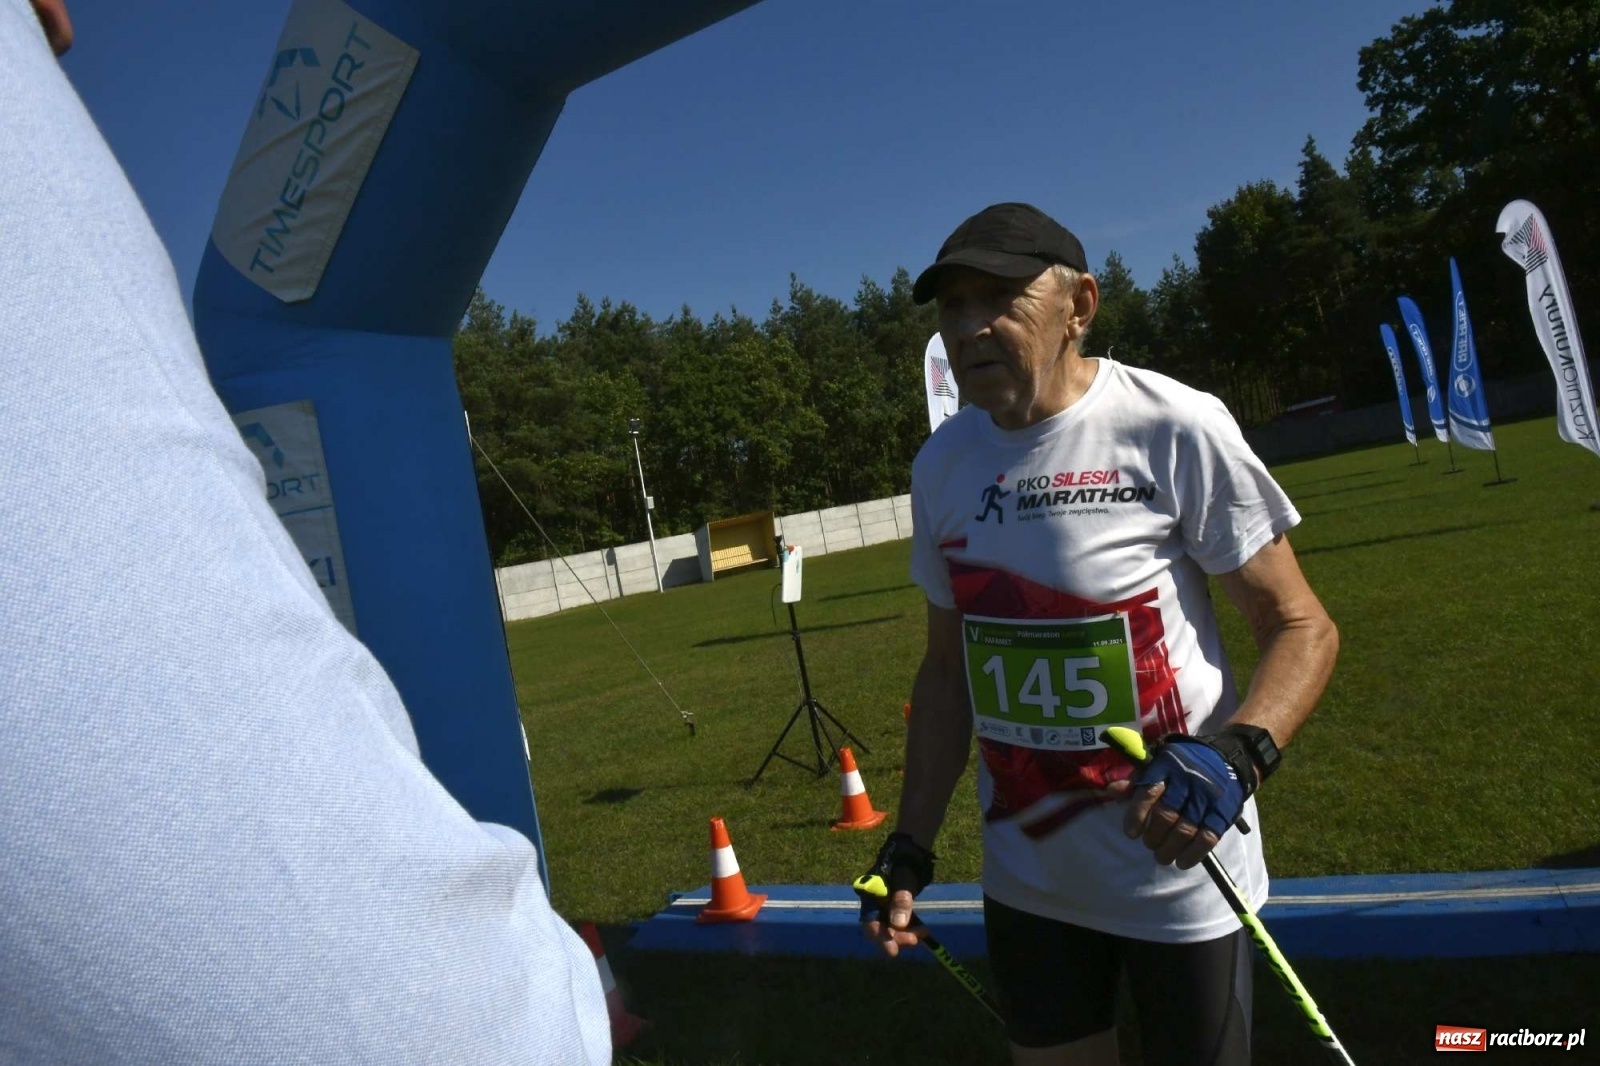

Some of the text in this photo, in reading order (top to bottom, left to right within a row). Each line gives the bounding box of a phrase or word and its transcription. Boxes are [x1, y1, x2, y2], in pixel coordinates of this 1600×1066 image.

[250, 22, 372, 274] TIMESPORT
[1016, 469, 1121, 493] PKO SILESIA
[1016, 485, 1157, 511] MARATHON
[969, 626, 980, 642] V
[982, 655, 1109, 719] 145
